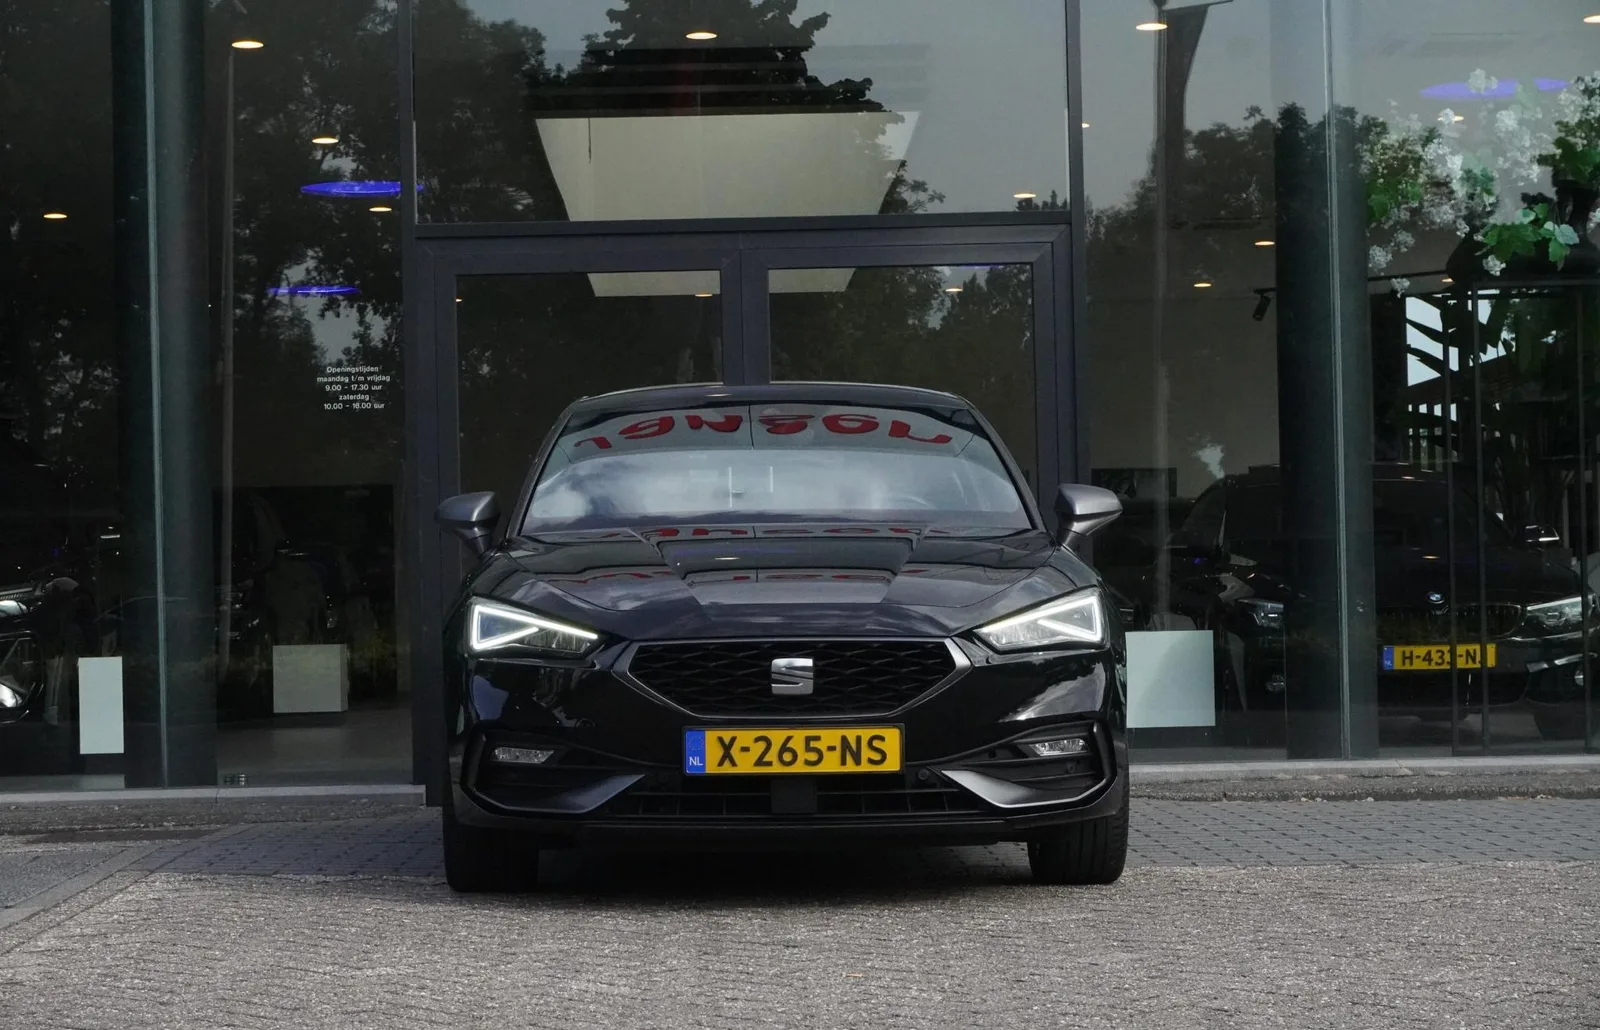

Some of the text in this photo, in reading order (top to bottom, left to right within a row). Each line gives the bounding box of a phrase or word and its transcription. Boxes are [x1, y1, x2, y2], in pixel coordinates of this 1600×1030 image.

[326, 365, 379, 373] Openingstijden
[316, 375, 349, 383] maandag
[366, 374, 391, 382] vrijdag
[351, 383, 369, 391] 17.30
[689, 734, 888, 768] NL X-265-NS
